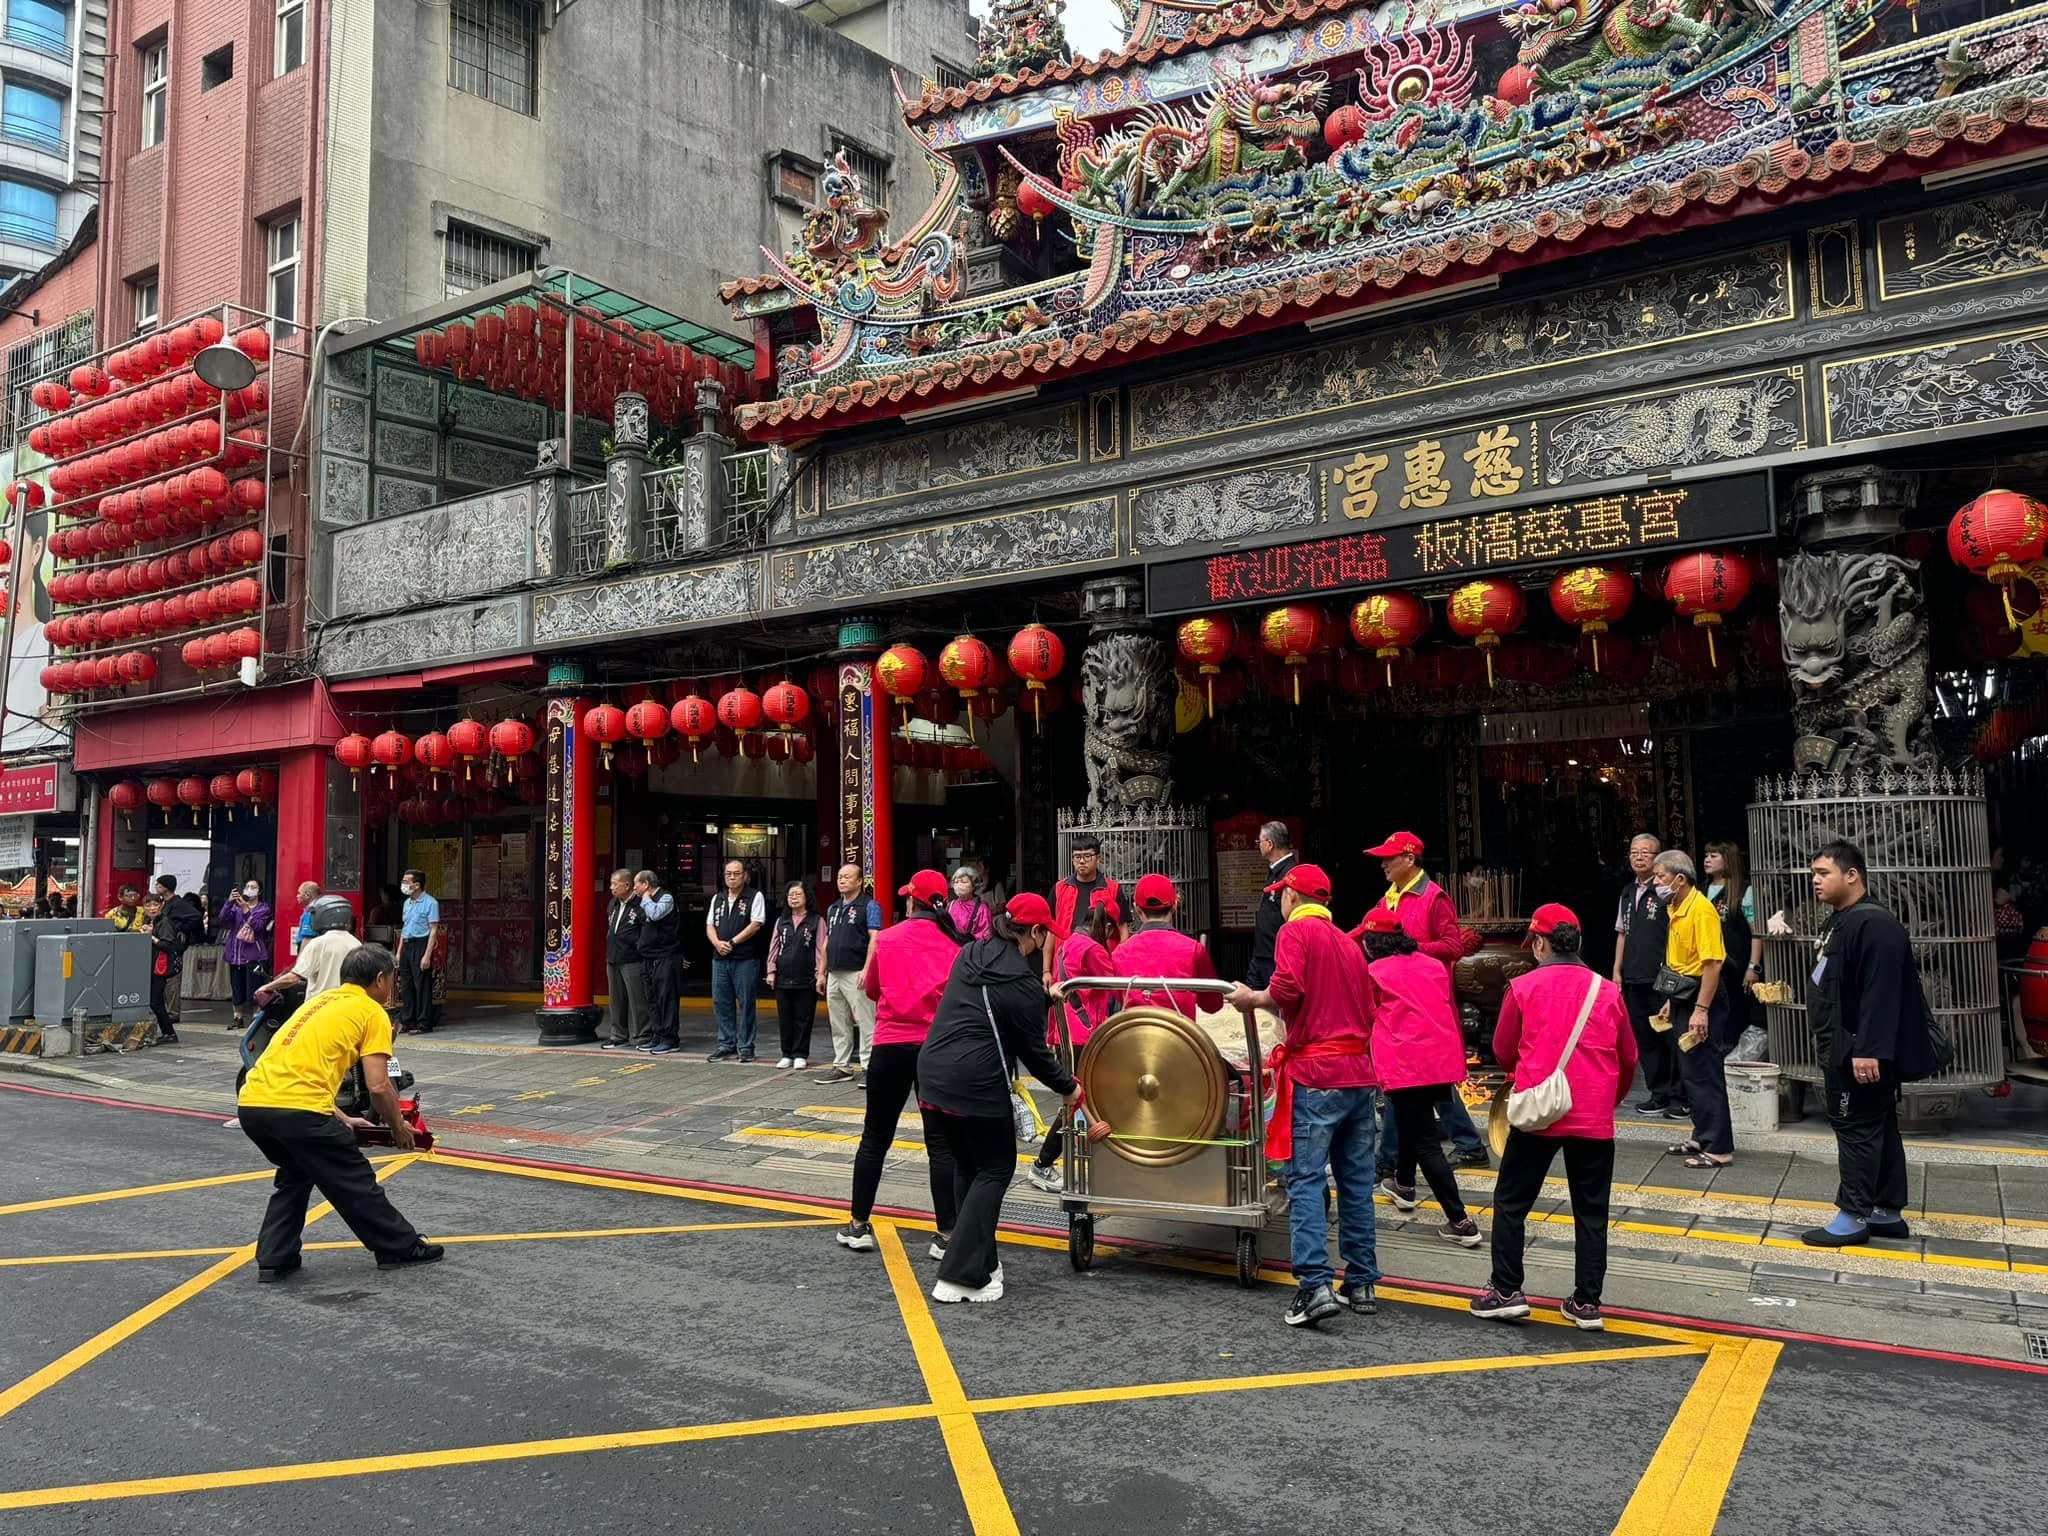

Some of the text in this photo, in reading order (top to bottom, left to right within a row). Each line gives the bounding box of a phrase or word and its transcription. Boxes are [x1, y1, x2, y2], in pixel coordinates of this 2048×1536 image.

[1333, 424, 1524, 520] 慈惠宮
[1205, 533, 1389, 602] 歡迎蒞臨
[1414, 489, 1688, 573] 板橋慈惠宮
